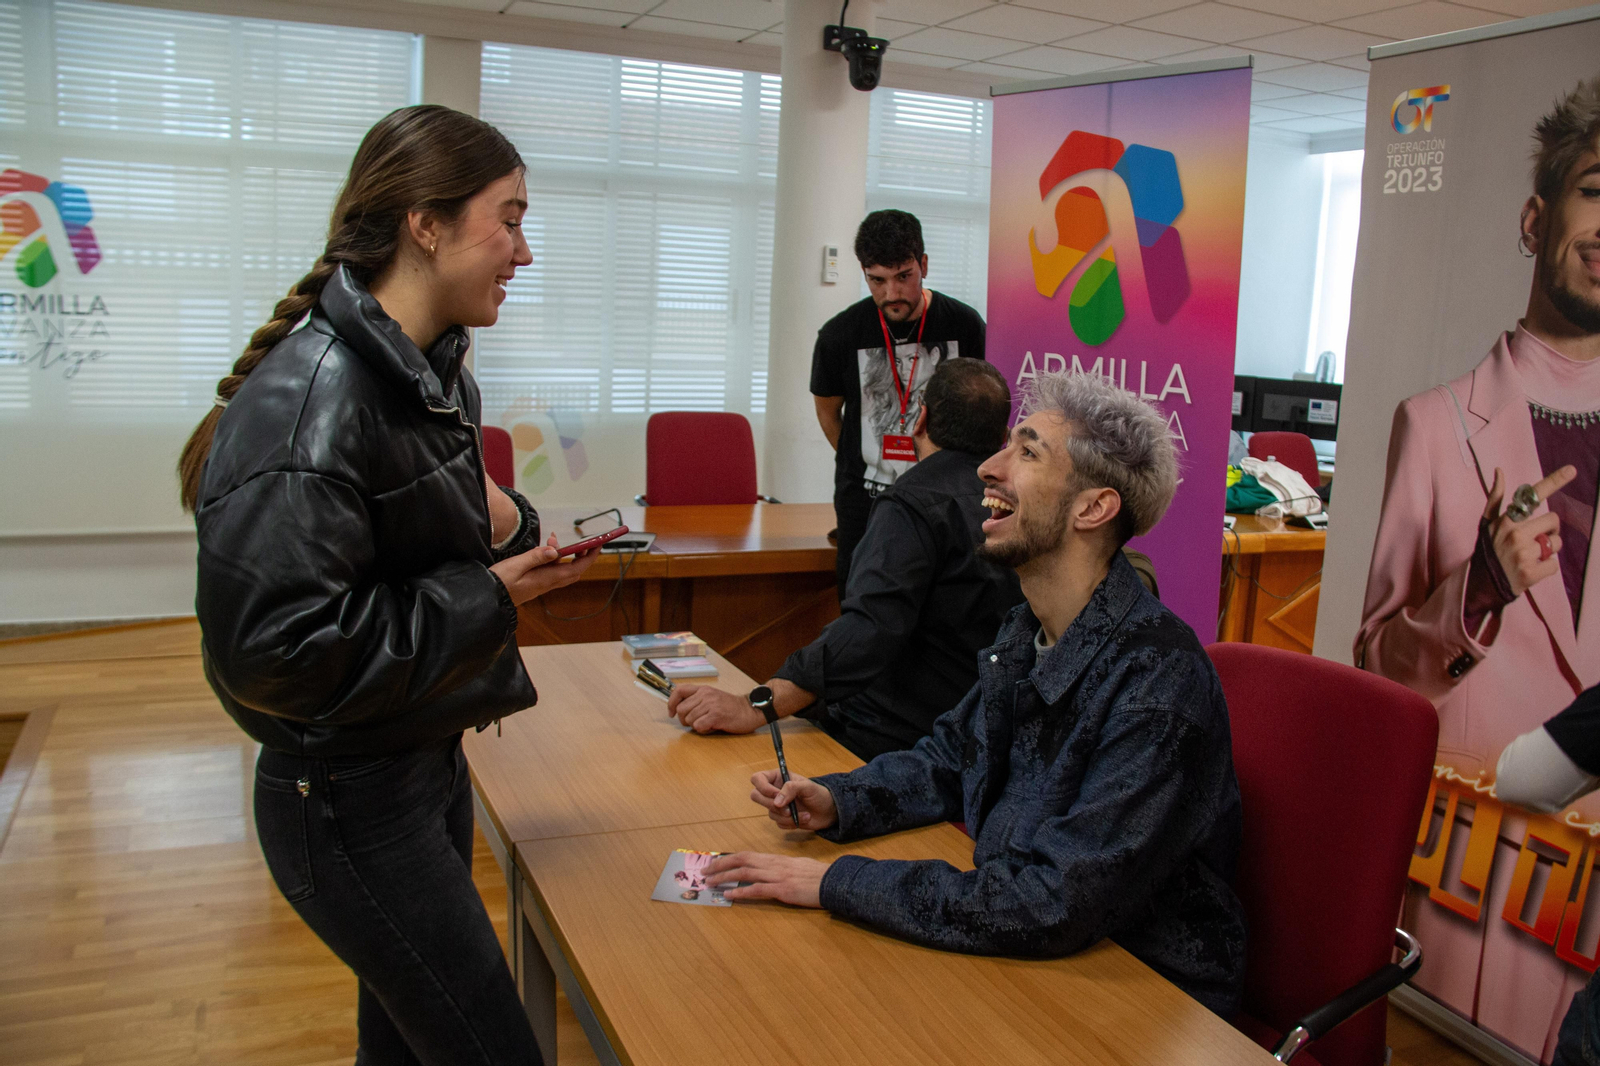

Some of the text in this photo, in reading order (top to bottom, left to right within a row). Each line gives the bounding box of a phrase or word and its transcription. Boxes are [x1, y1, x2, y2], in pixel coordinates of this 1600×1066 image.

[1386, 137, 1446, 155] OPERACIÓN
[1386, 151, 1445, 168] TRIUNFO
[1383, 166, 1443, 194] 2023
